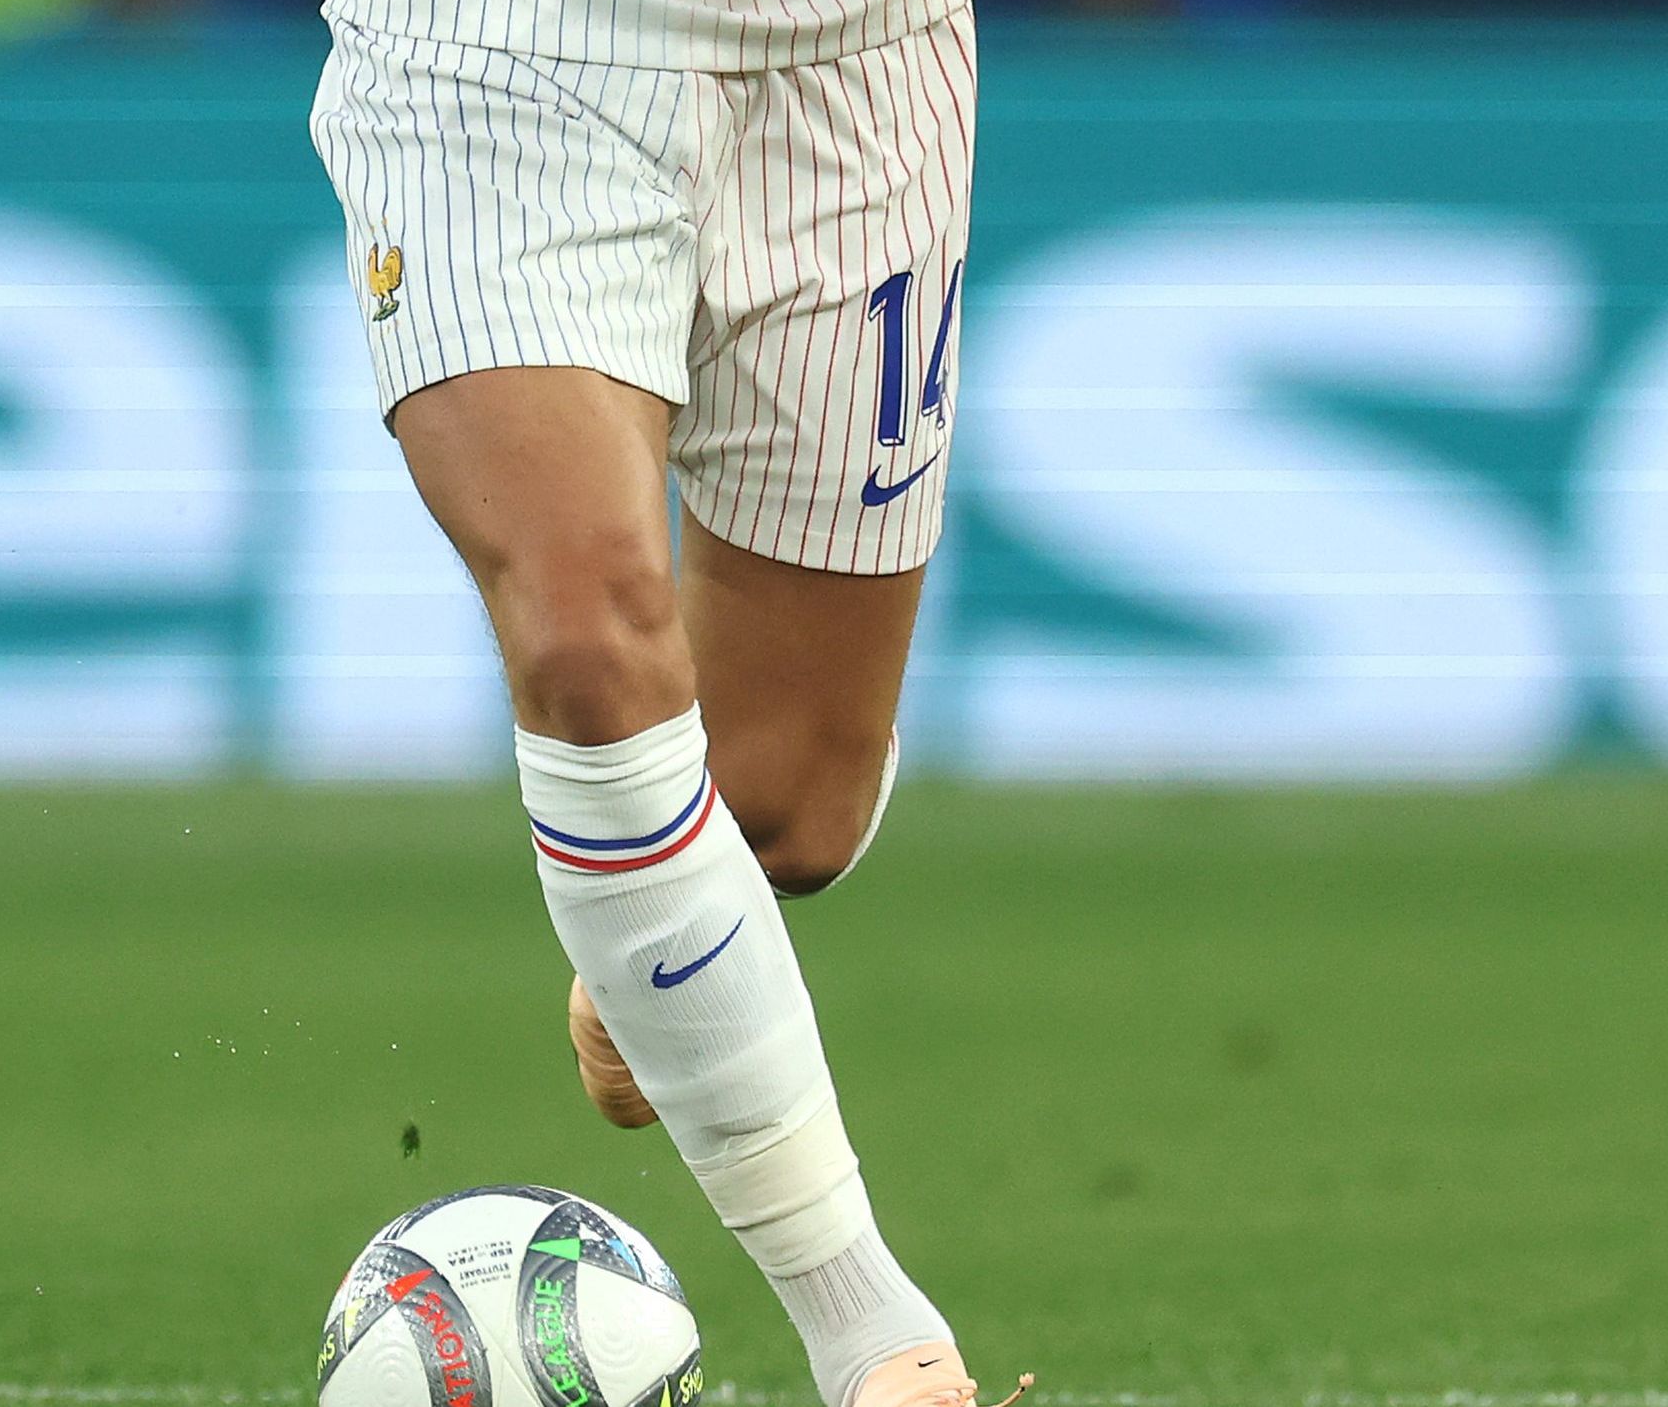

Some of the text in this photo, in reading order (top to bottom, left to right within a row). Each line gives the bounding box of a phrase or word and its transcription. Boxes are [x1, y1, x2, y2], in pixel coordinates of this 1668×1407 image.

[447, 1254, 475, 1267] FRA
[490, 1247, 513, 1258] ESP
[459, 1262, 510, 1281] STUTTGART
[534, 1276, 590, 1407] LEAGUE
